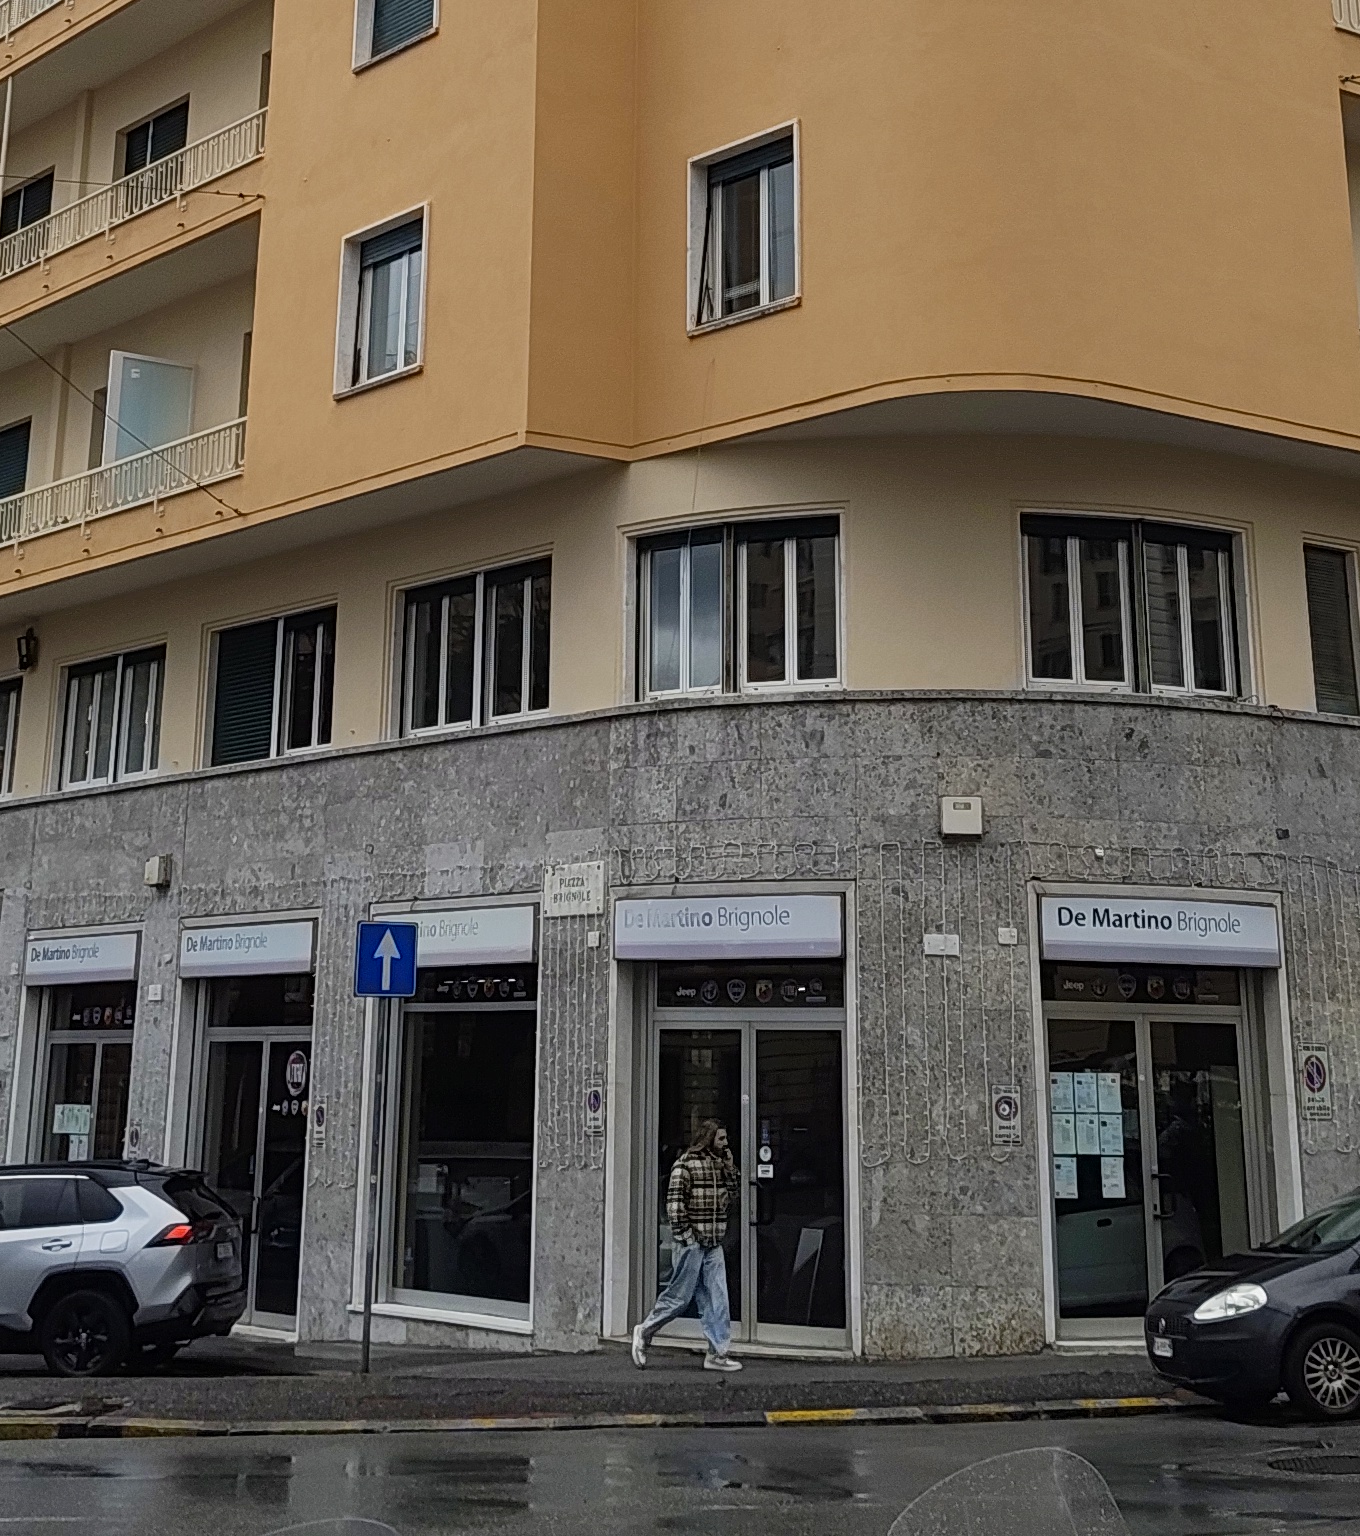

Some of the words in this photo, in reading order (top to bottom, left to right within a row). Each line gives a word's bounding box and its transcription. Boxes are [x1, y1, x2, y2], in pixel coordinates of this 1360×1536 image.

[559, 876, 585, 888] PIAZZA
[553, 890, 591, 904] BRIGNOLE
[624, 909, 644, 929] De
[647, 906, 713, 929] Martino
[717, 904, 791, 932] Brignole
[1057, 906, 1086, 927] De
[1092, 907, 1172, 931] Martino
[1177, 910, 1241, 937] Brignole
[439, 917, 479, 942] Brignole
[30, 947, 41, 962] De
[41, 947, 71, 962] Martino
[71, 942, 100, 964] Brignole
[186, 936, 198, 953] De
[199, 935, 234, 951] Martino
[234, 931, 268, 953] Brignole
[676, 986, 697, 998] Jeep
[1063, 979, 1085, 992] Jeep
